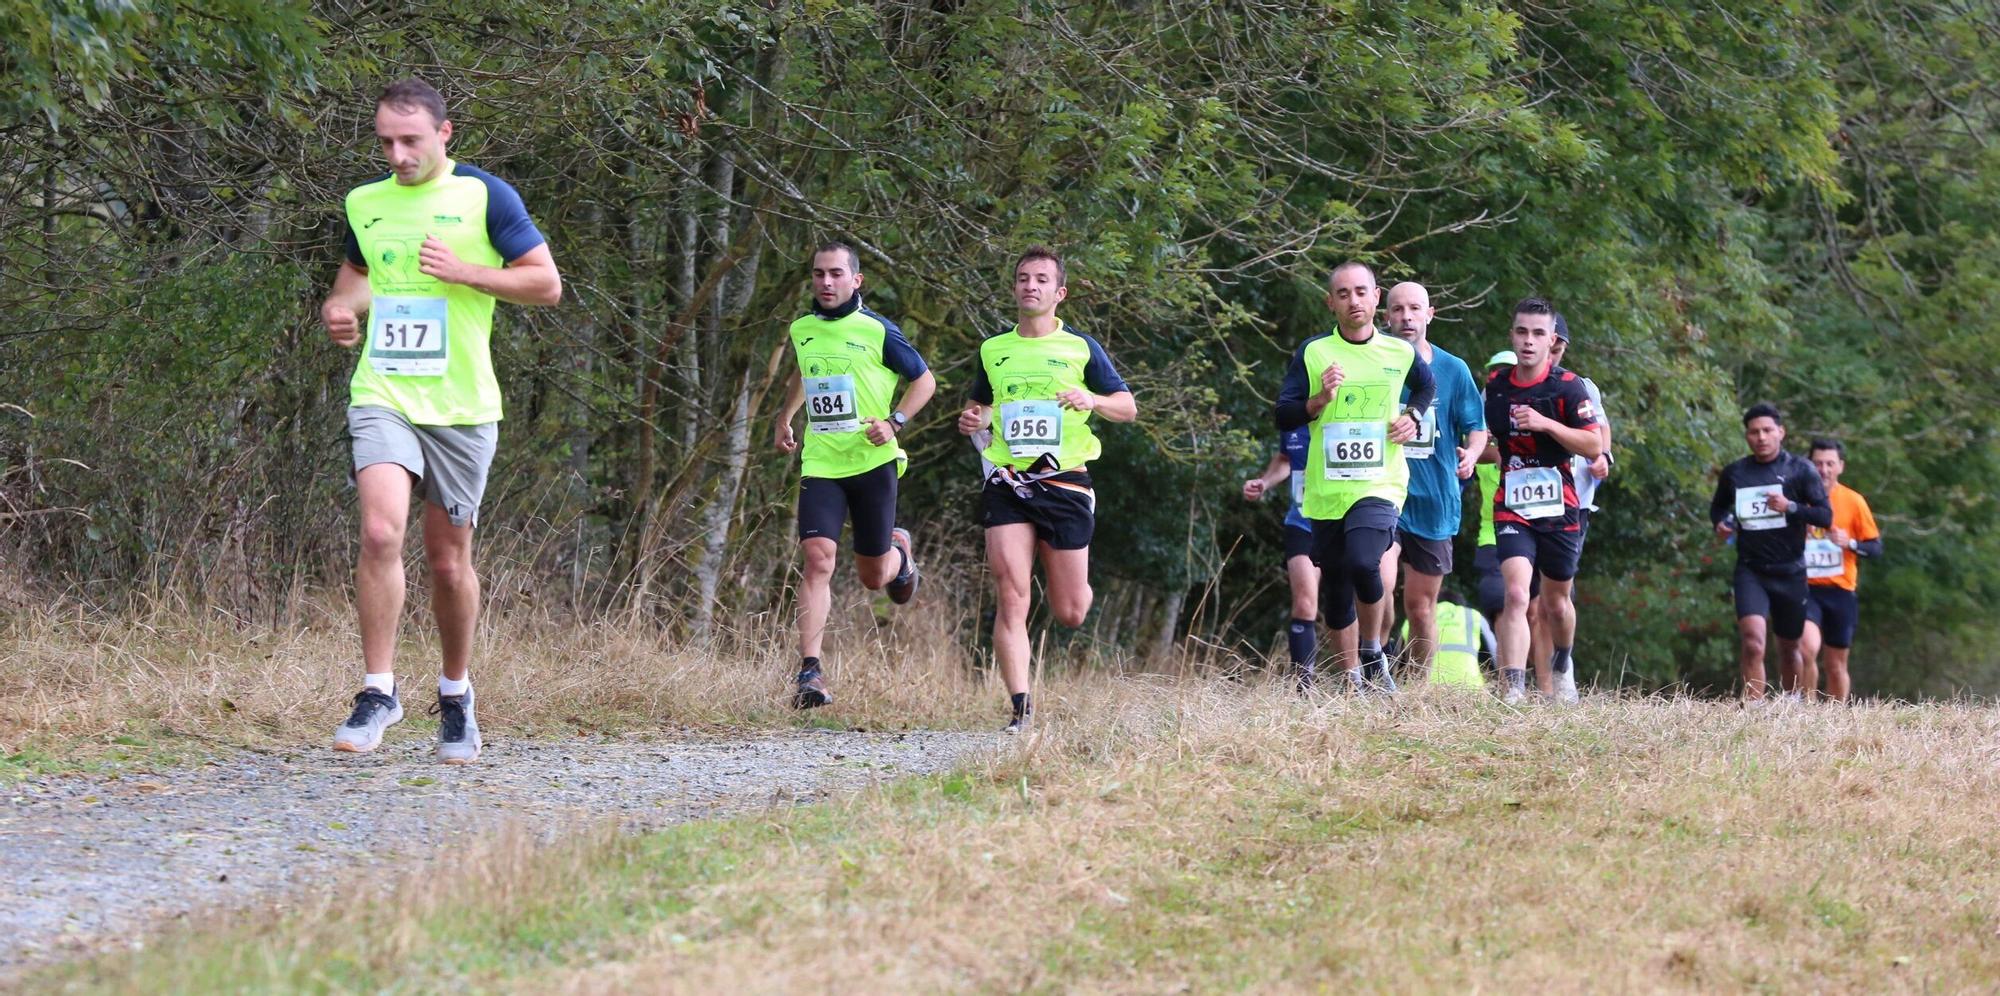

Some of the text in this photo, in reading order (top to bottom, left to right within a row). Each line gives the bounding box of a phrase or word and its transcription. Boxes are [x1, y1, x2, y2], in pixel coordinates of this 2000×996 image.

[385, 323, 428, 348] 517
[812, 394, 844, 415] 684
[1010, 419, 1048, 438] 956
[1336, 442, 1374, 461] 686
[1512, 484, 1554, 502] 1041
